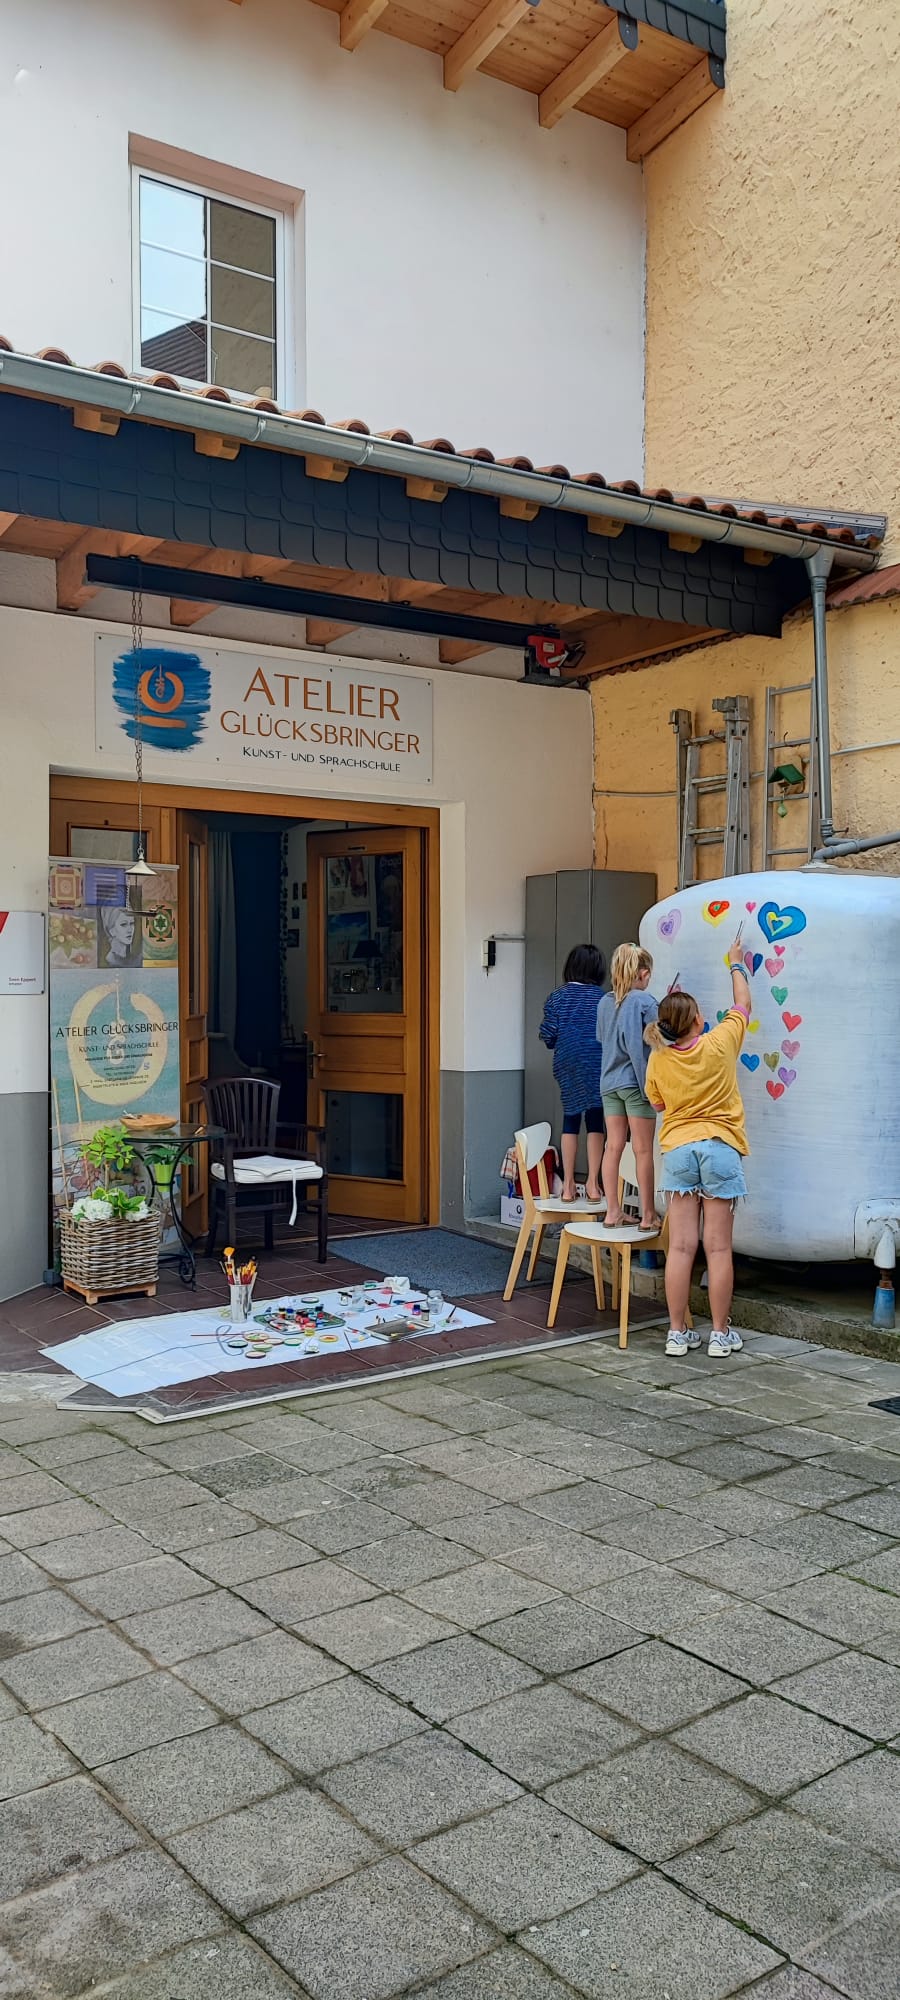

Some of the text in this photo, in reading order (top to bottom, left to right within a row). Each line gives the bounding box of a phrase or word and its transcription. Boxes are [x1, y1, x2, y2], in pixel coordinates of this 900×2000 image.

[243, 667, 400, 721] ATELIER
[219, 710, 420, 754] GLÜCKSBRINGER
[242, 746, 401, 773] KUNST- UND SPRACHSCHULE
[55, 1026, 98, 1038] ATELIER
